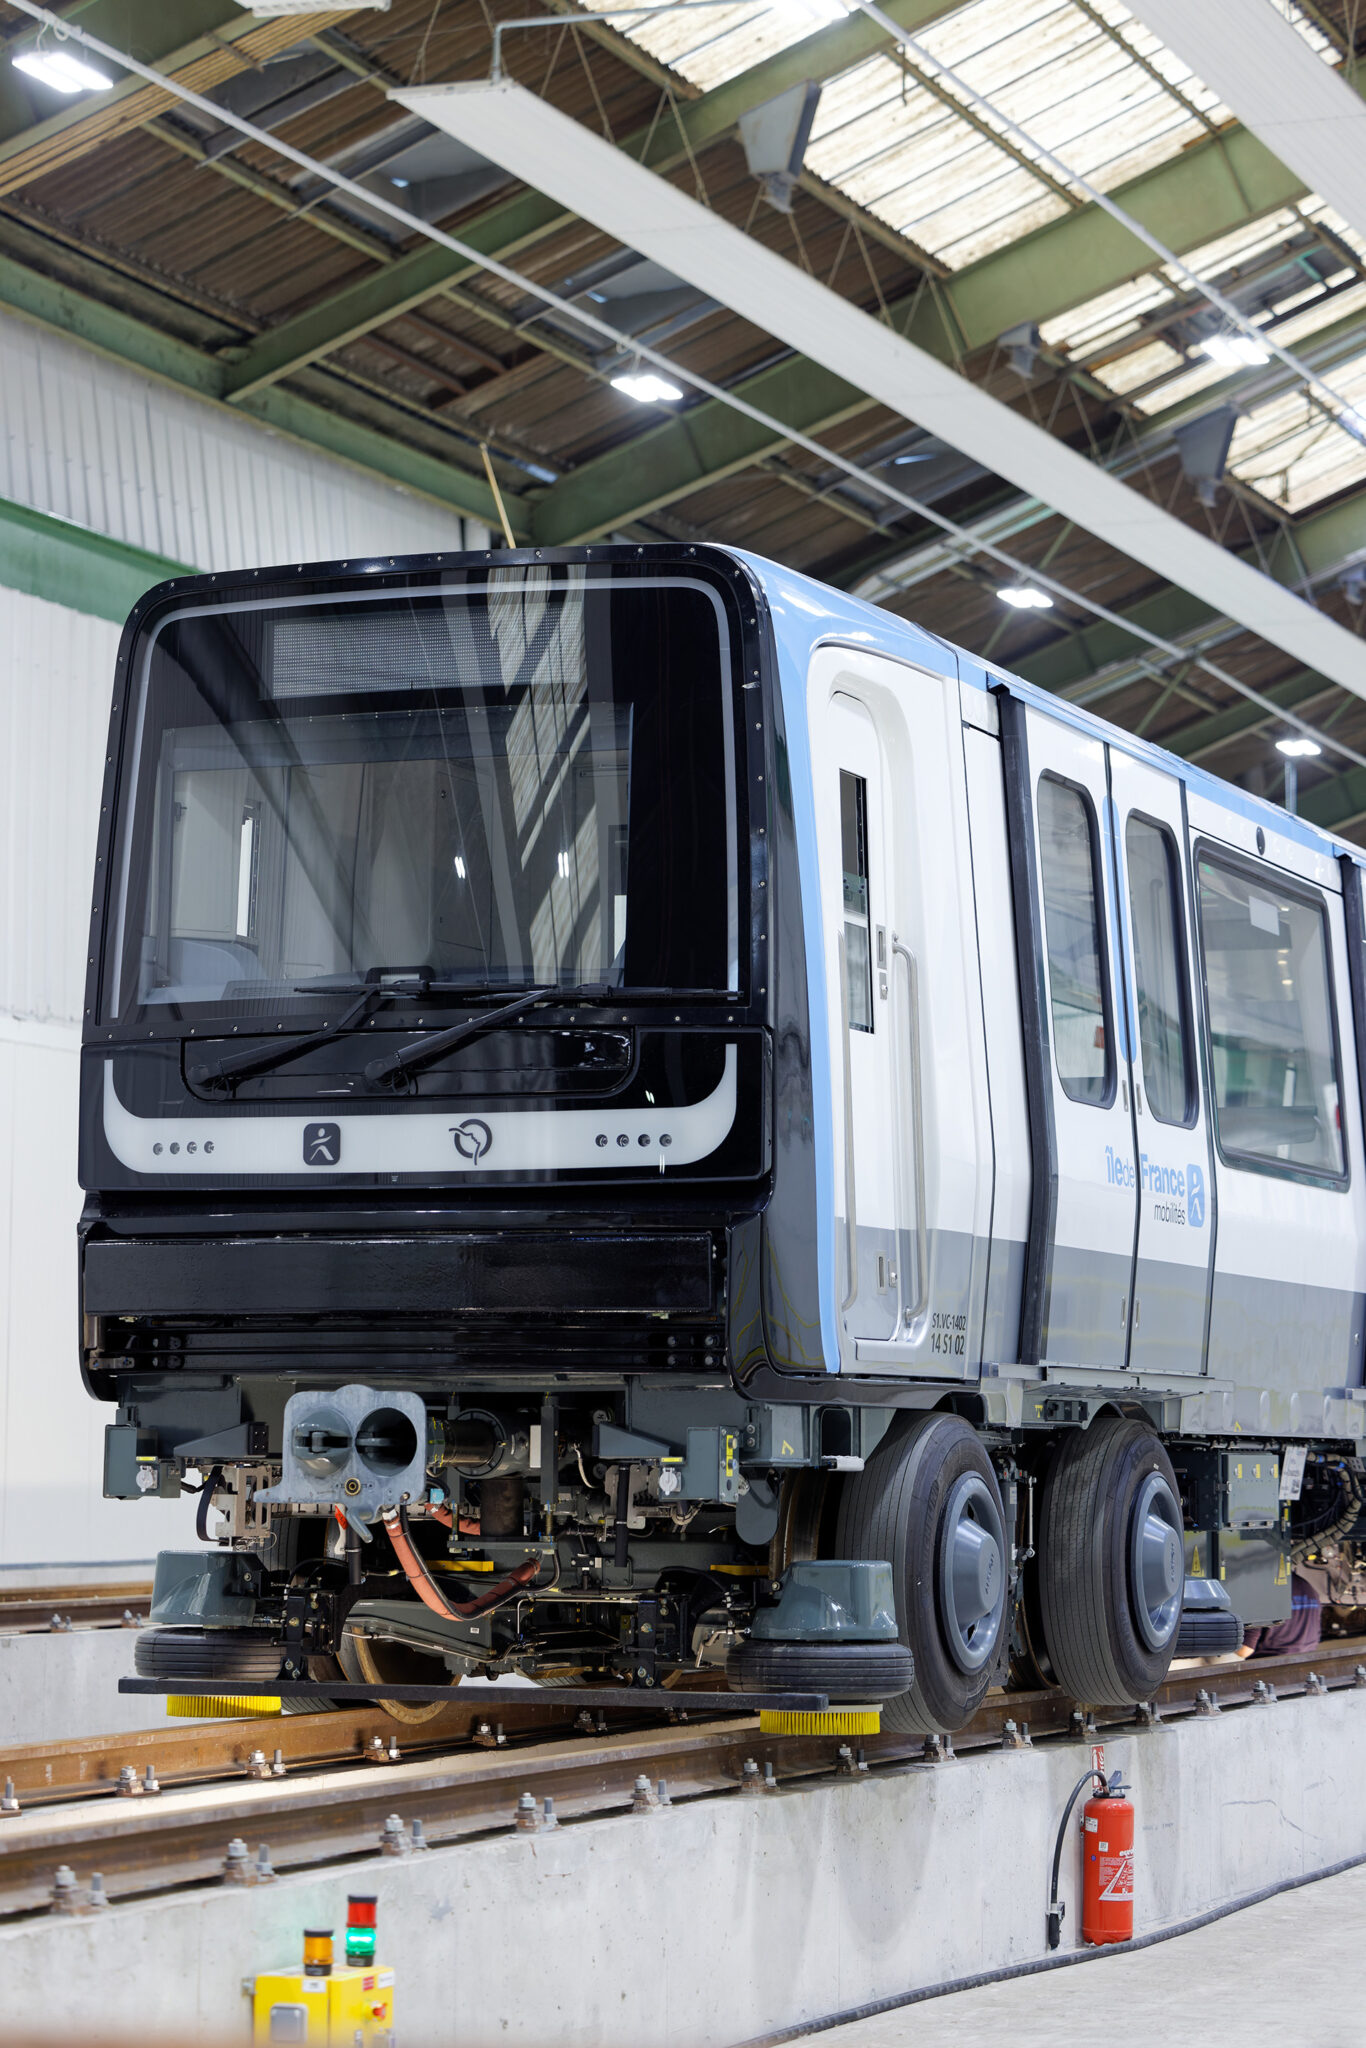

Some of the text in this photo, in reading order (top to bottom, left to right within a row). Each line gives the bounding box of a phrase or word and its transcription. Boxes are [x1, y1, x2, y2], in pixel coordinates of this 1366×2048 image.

[1154, 1201, 1185, 1225] mobilités
[931, 1333, 965, 1356] 14 S1 02
